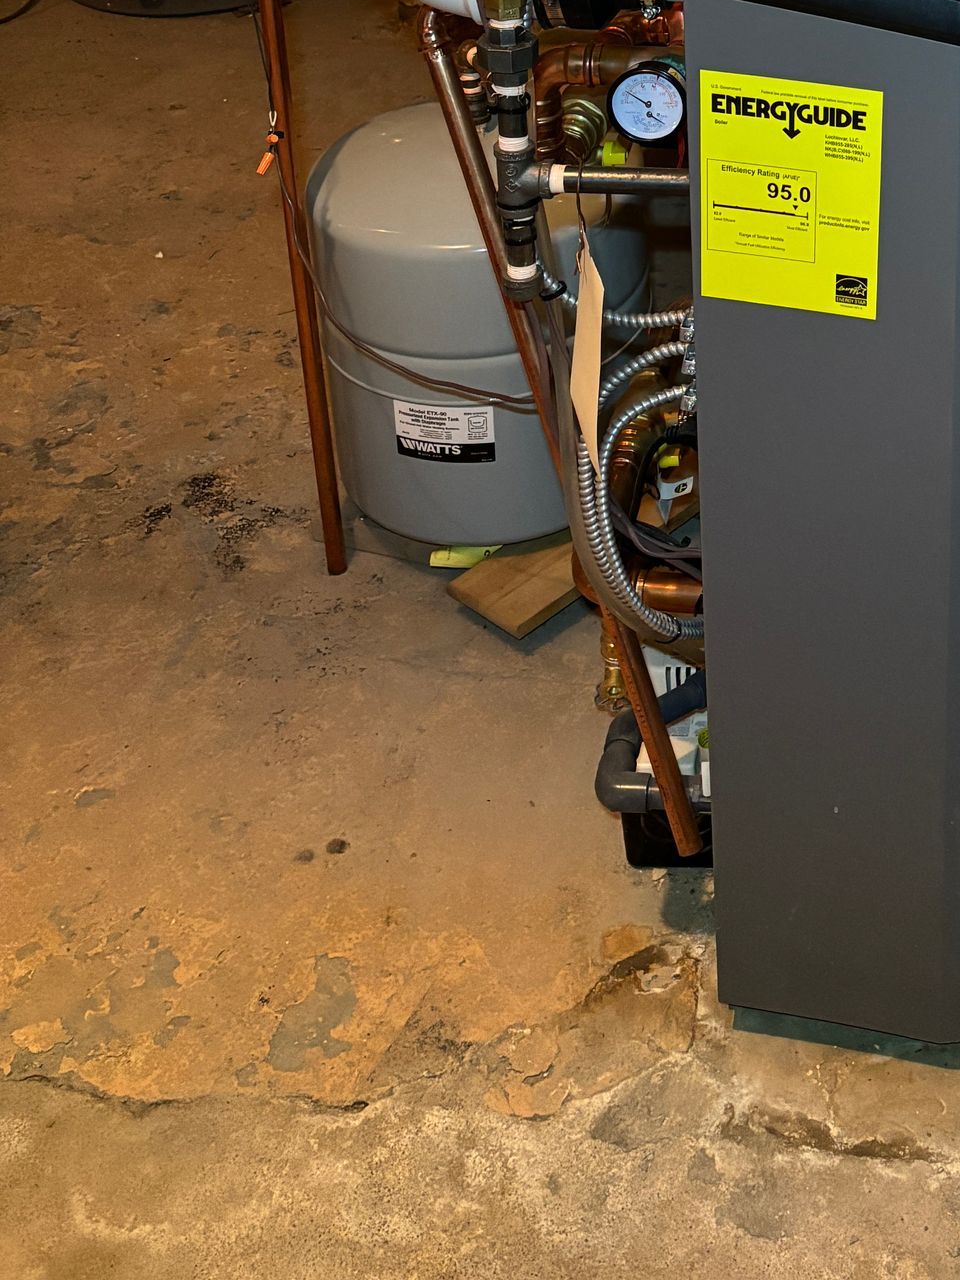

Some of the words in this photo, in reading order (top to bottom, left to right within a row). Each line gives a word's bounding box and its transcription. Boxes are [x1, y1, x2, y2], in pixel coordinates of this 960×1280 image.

[711, 93, 867, 132] ENERGYGUIDE
[721, 164, 756, 176] Efficiency
[757, 168, 780, 179] Rating
[767, 182, 811, 203] 95.0
[408, 407, 425, 415] Model
[423, 414, 447, 422] Expansion
[416, 441, 462, 455] WATTS
